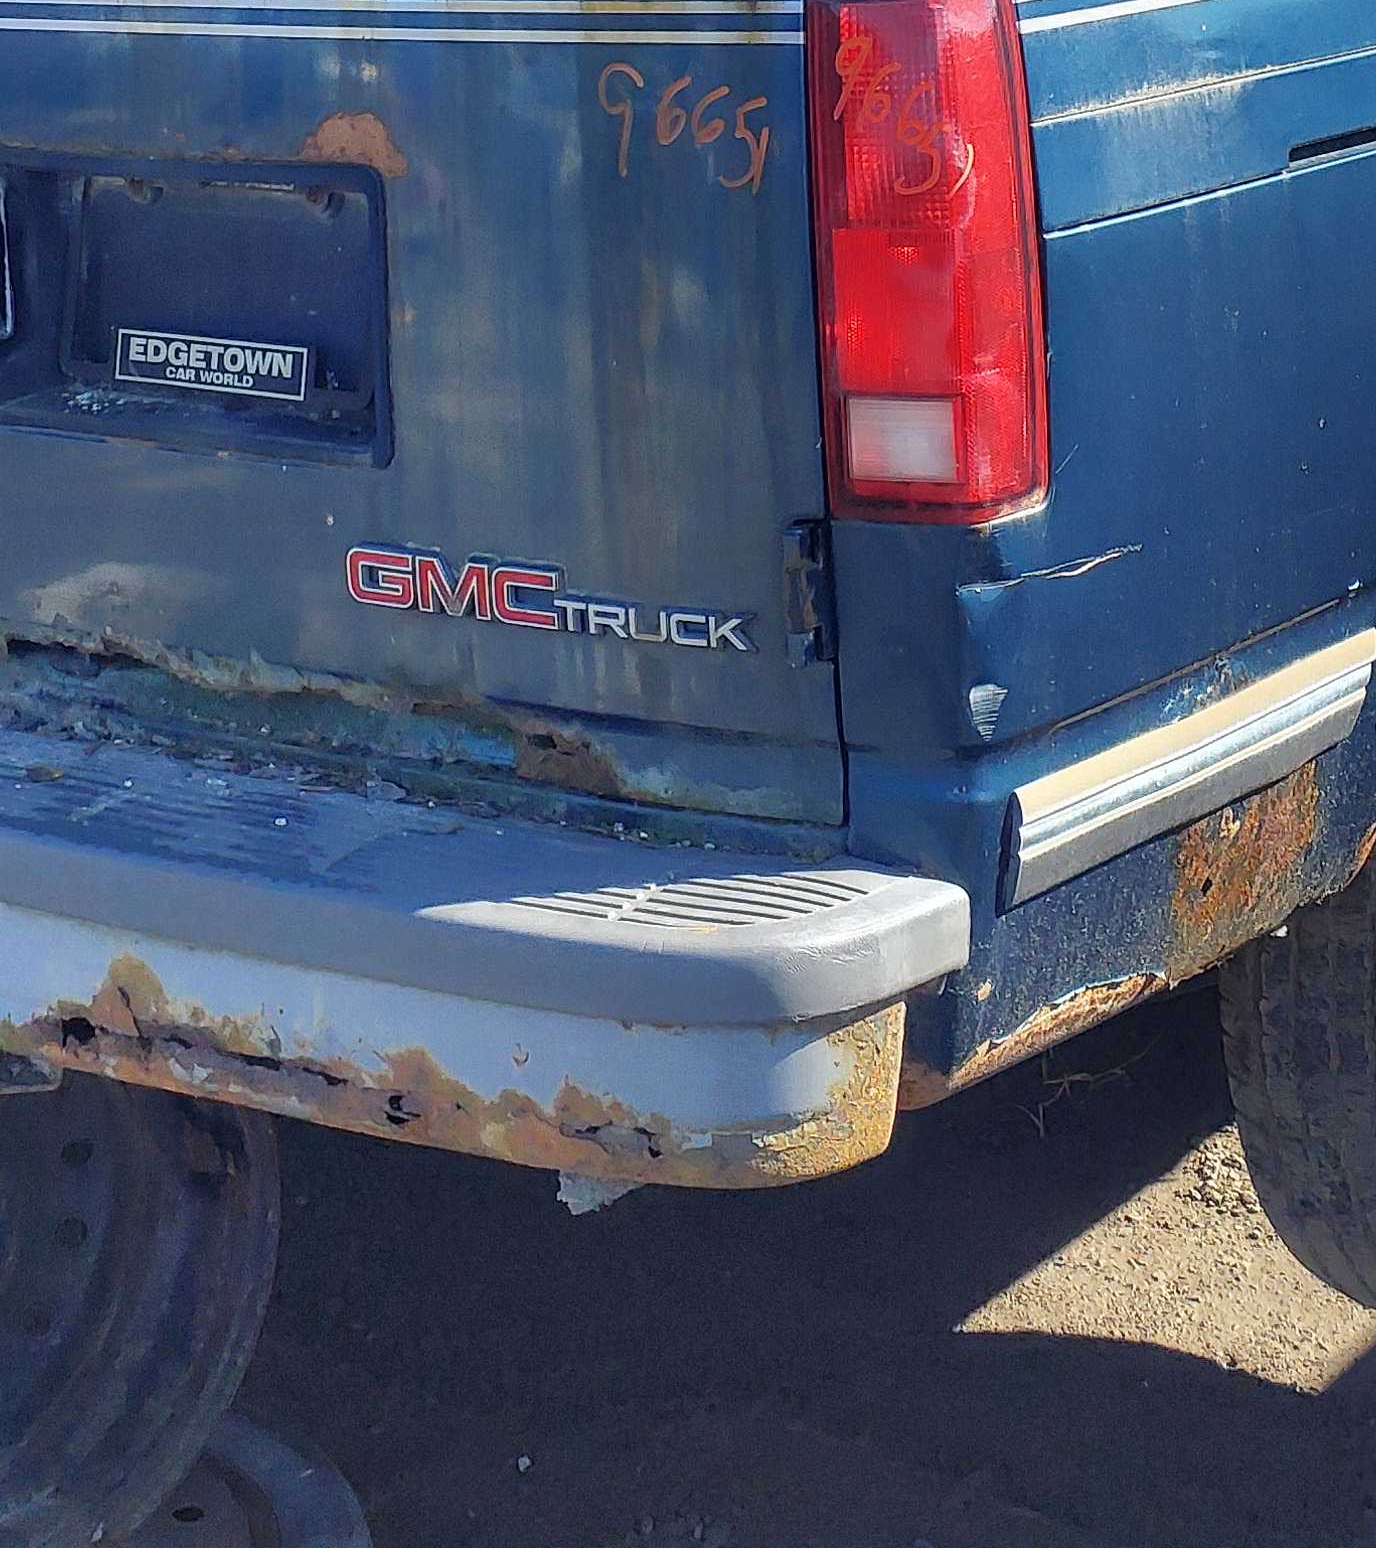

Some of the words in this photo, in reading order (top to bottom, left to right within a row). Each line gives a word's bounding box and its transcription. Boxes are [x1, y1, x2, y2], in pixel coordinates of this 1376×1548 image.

[128, 336, 294, 379] EDGETOWN
[165, 365, 196, 382] CAR
[199, 369, 254, 389] WORLD
[345, 546, 561, 631] GMC
[553, 597, 749, 652] TRUCK
